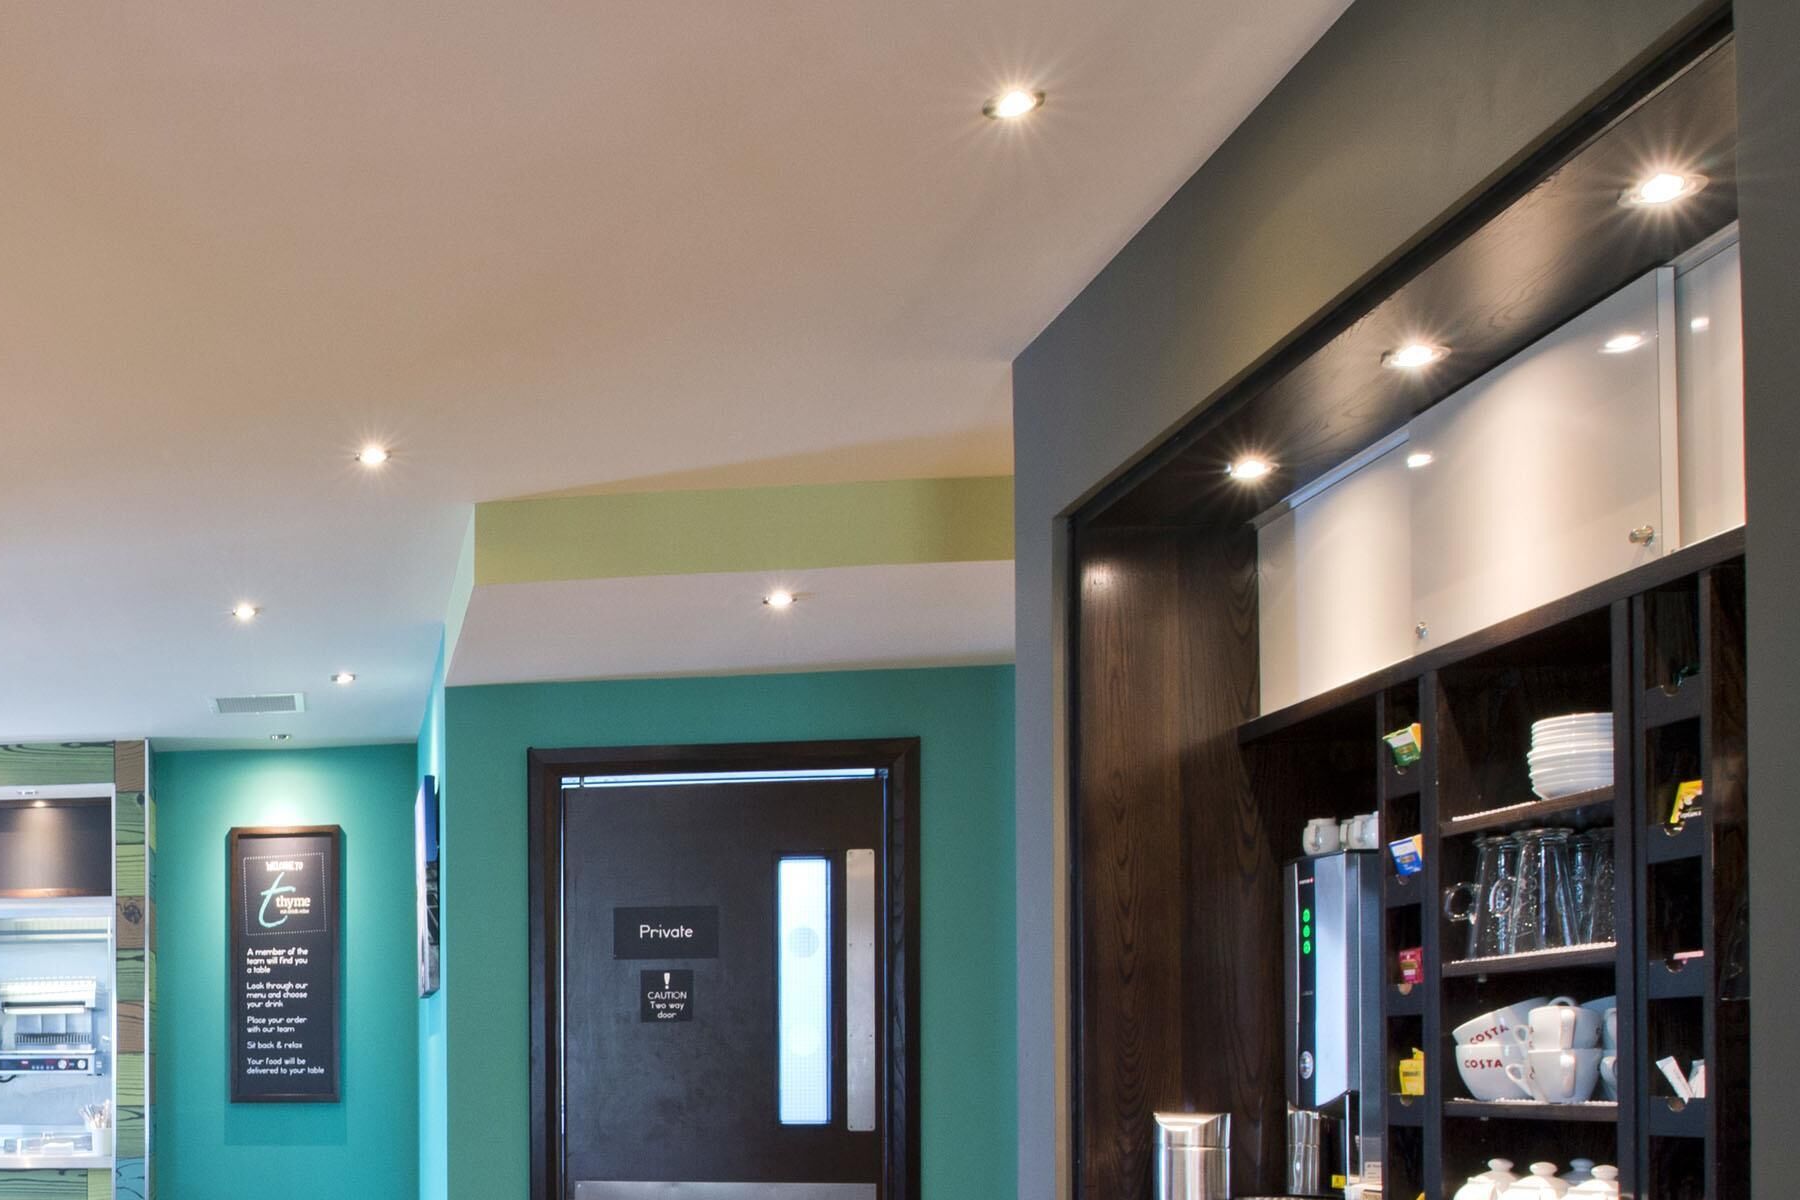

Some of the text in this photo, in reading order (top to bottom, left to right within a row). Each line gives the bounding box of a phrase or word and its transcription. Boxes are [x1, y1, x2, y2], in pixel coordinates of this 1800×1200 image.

[294, 861, 304, 871] TO
[275, 894, 311, 909] thyme
[640, 924, 694, 938] Private
[255, 947, 286, 955] member
[287, 947, 296, 955] of
[297, 947, 308, 955] the
[279, 956, 293, 964] find
[295, 958, 308, 966] you
[247, 982, 264, 990] Look
[266, 982, 293, 992] through
[648, 991, 687, 1000] CAUTION
[247, 1002, 263, 1010] your
[650, 1001, 666, 1009] Two
[657, 1010, 677, 1019] door
[247, 1016, 266, 1024] Place
[1470, 1024, 1510, 1045] COSTA
[247, 1041, 256, 1049] Sit
[258, 1041, 274, 1049] back
[1464, 1059, 1503, 1069] COSTA
[247, 1066, 278, 1074] delivered
[289, 1068, 306, 1076] your
[307, 1066, 324, 1074] table
